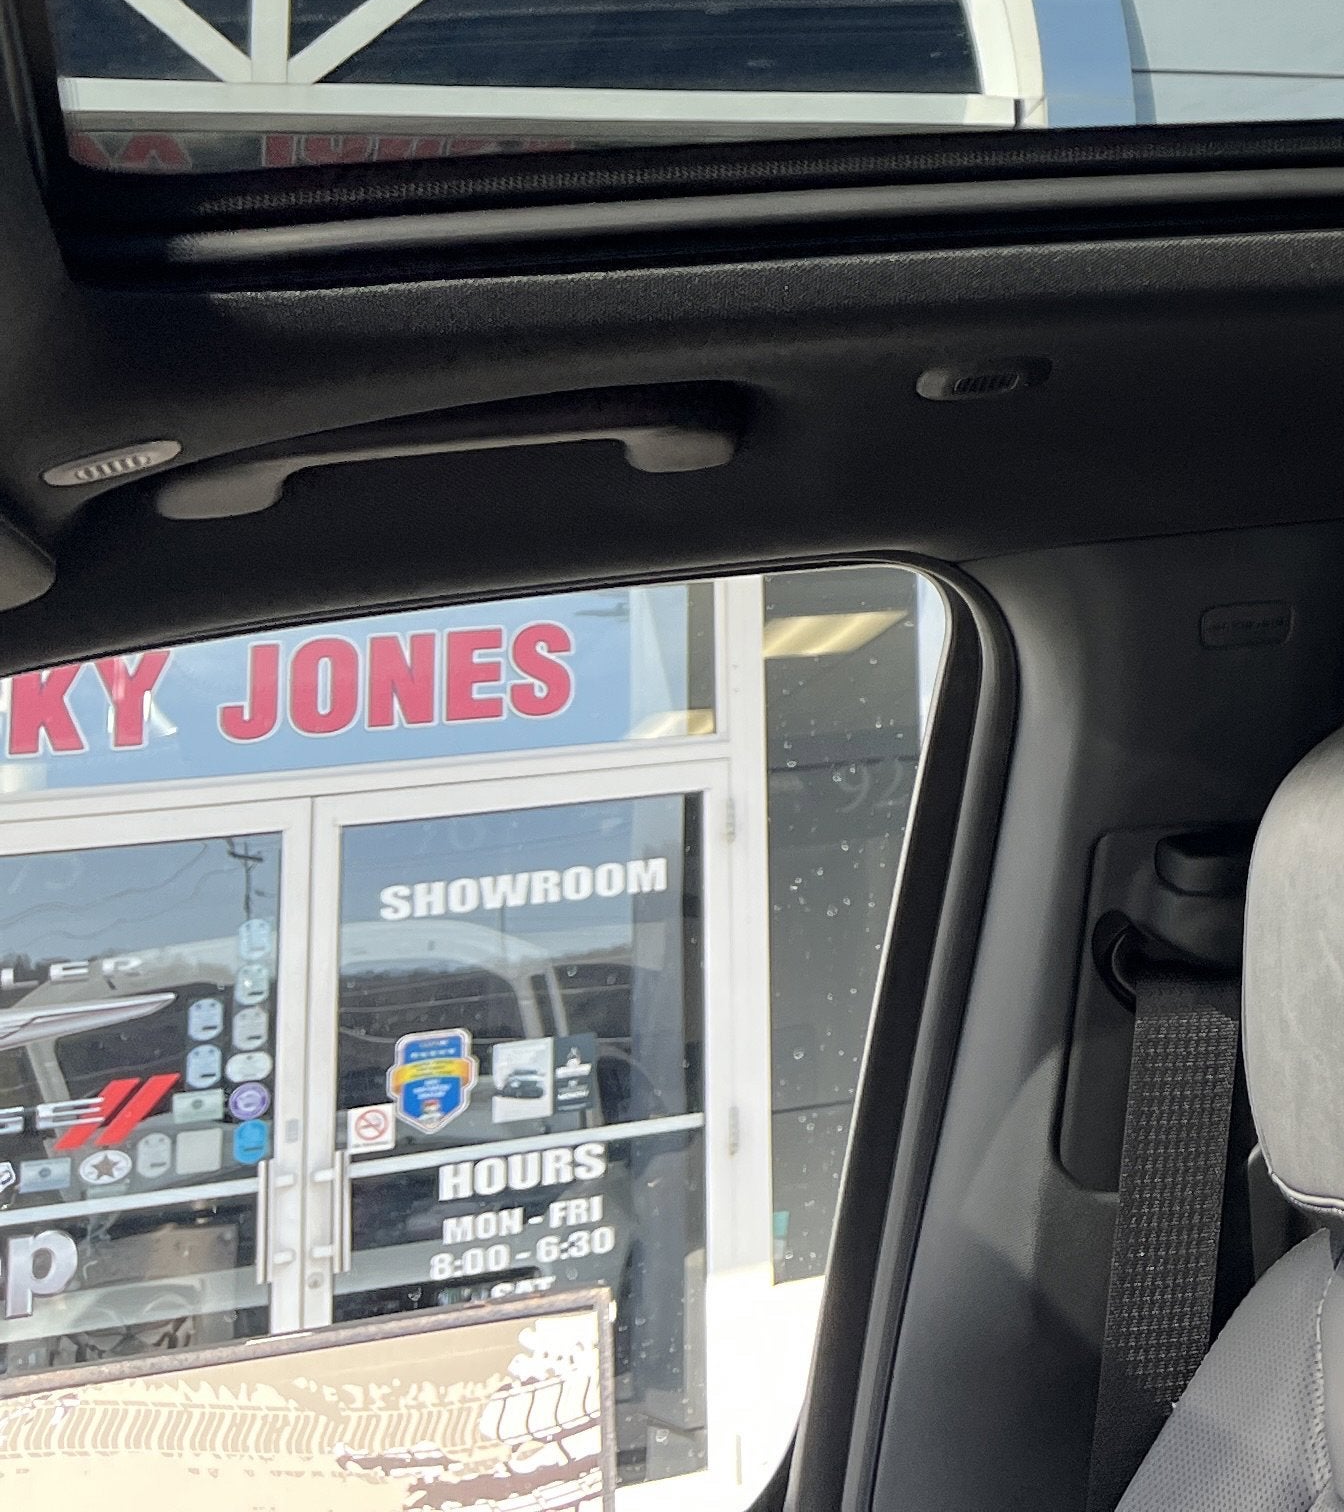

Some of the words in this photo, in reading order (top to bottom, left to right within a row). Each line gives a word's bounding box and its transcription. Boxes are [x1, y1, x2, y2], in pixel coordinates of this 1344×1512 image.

[216, 621, 574, 743] JONES
[379, 857, 668, 921] SHOWROOM
[438, 1142, 607, 1202] HOURS
[442, 1206, 525, 1245] MON
[549, 1194, 605, 1229] FRI
[430, 1243, 511, 1281] 8:00
[535, 1226, 616, 1264] 6:30
